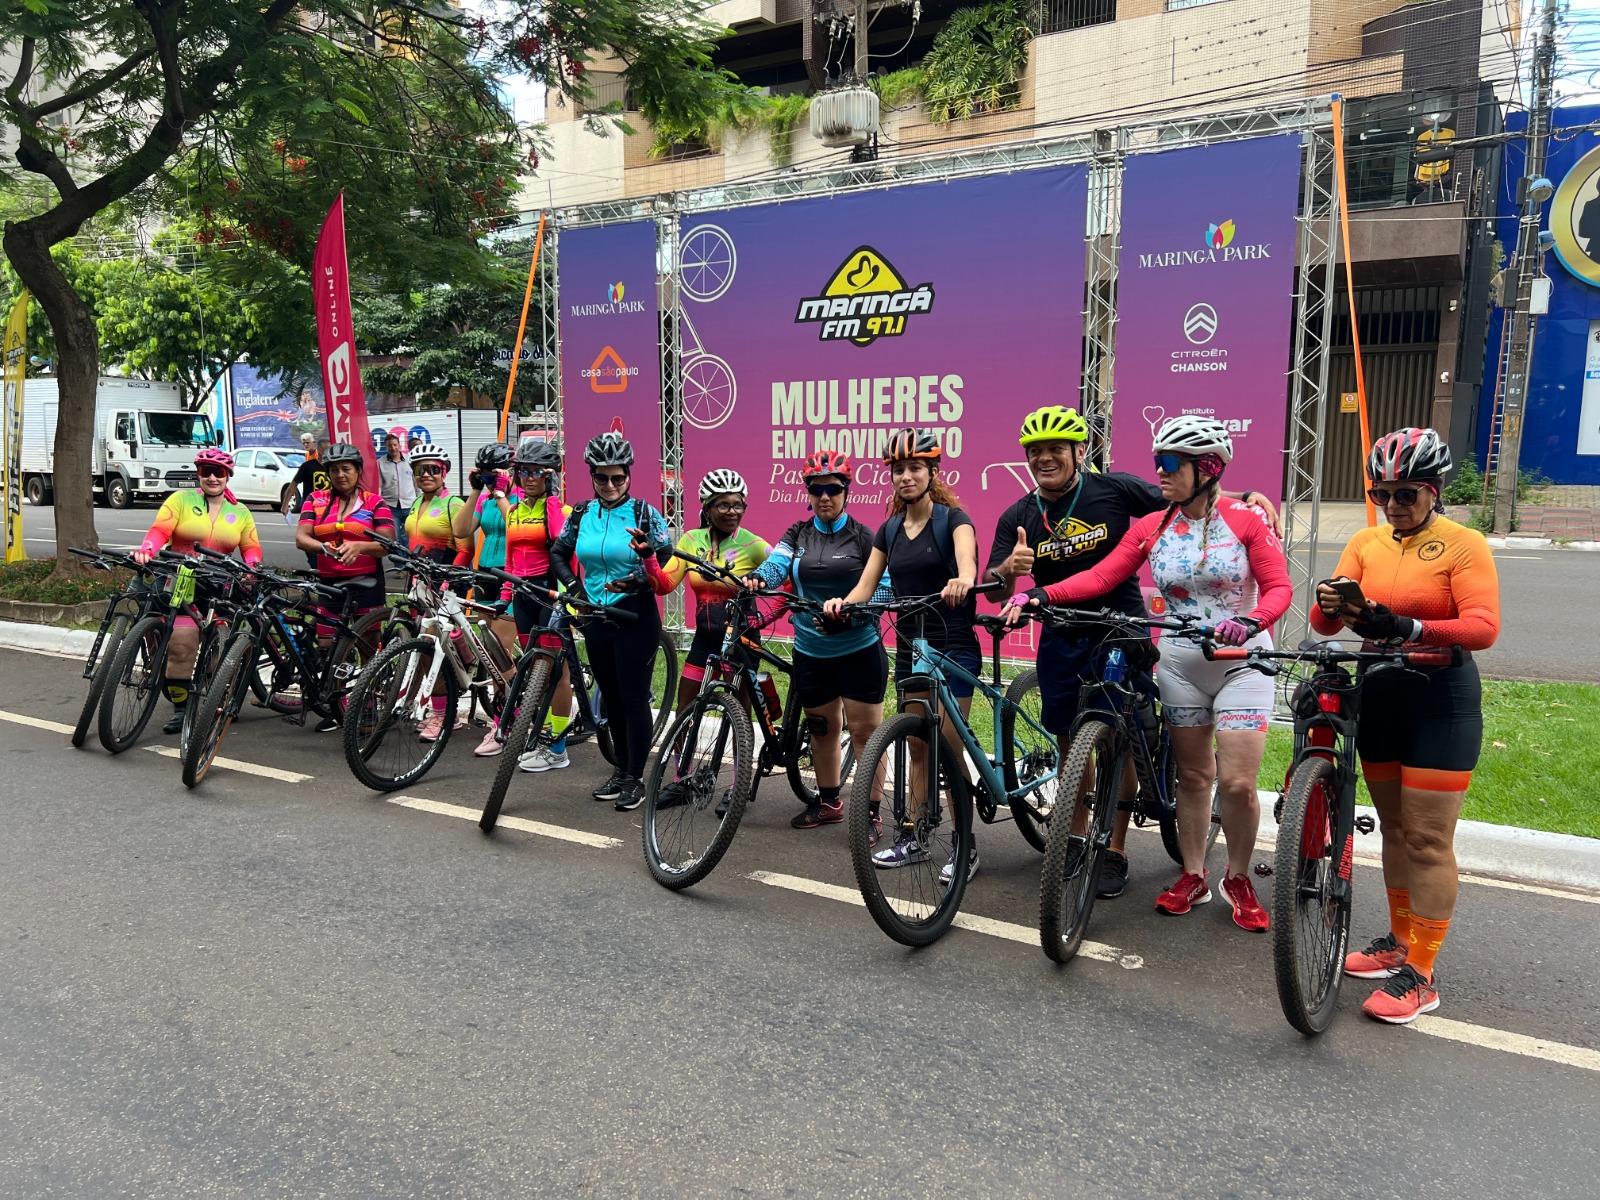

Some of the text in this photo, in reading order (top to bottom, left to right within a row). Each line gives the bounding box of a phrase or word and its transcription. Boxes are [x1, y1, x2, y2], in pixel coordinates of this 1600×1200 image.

[1222, 244, 1272, 262] PARK
[325, 265, 338, 338] ONLINE
[618, 300, 645, 313] PARK
[798, 287, 932, 319] MARINGÁ
[822, 315, 905, 339] FM 97.1
[1170, 362, 1227, 373] CHANSON
[771, 374, 964, 426] MULHERES
[1181, 407, 1215, 415] Instituto
[772, 429, 806, 459] EM
[769, 489, 792, 503] Dia
